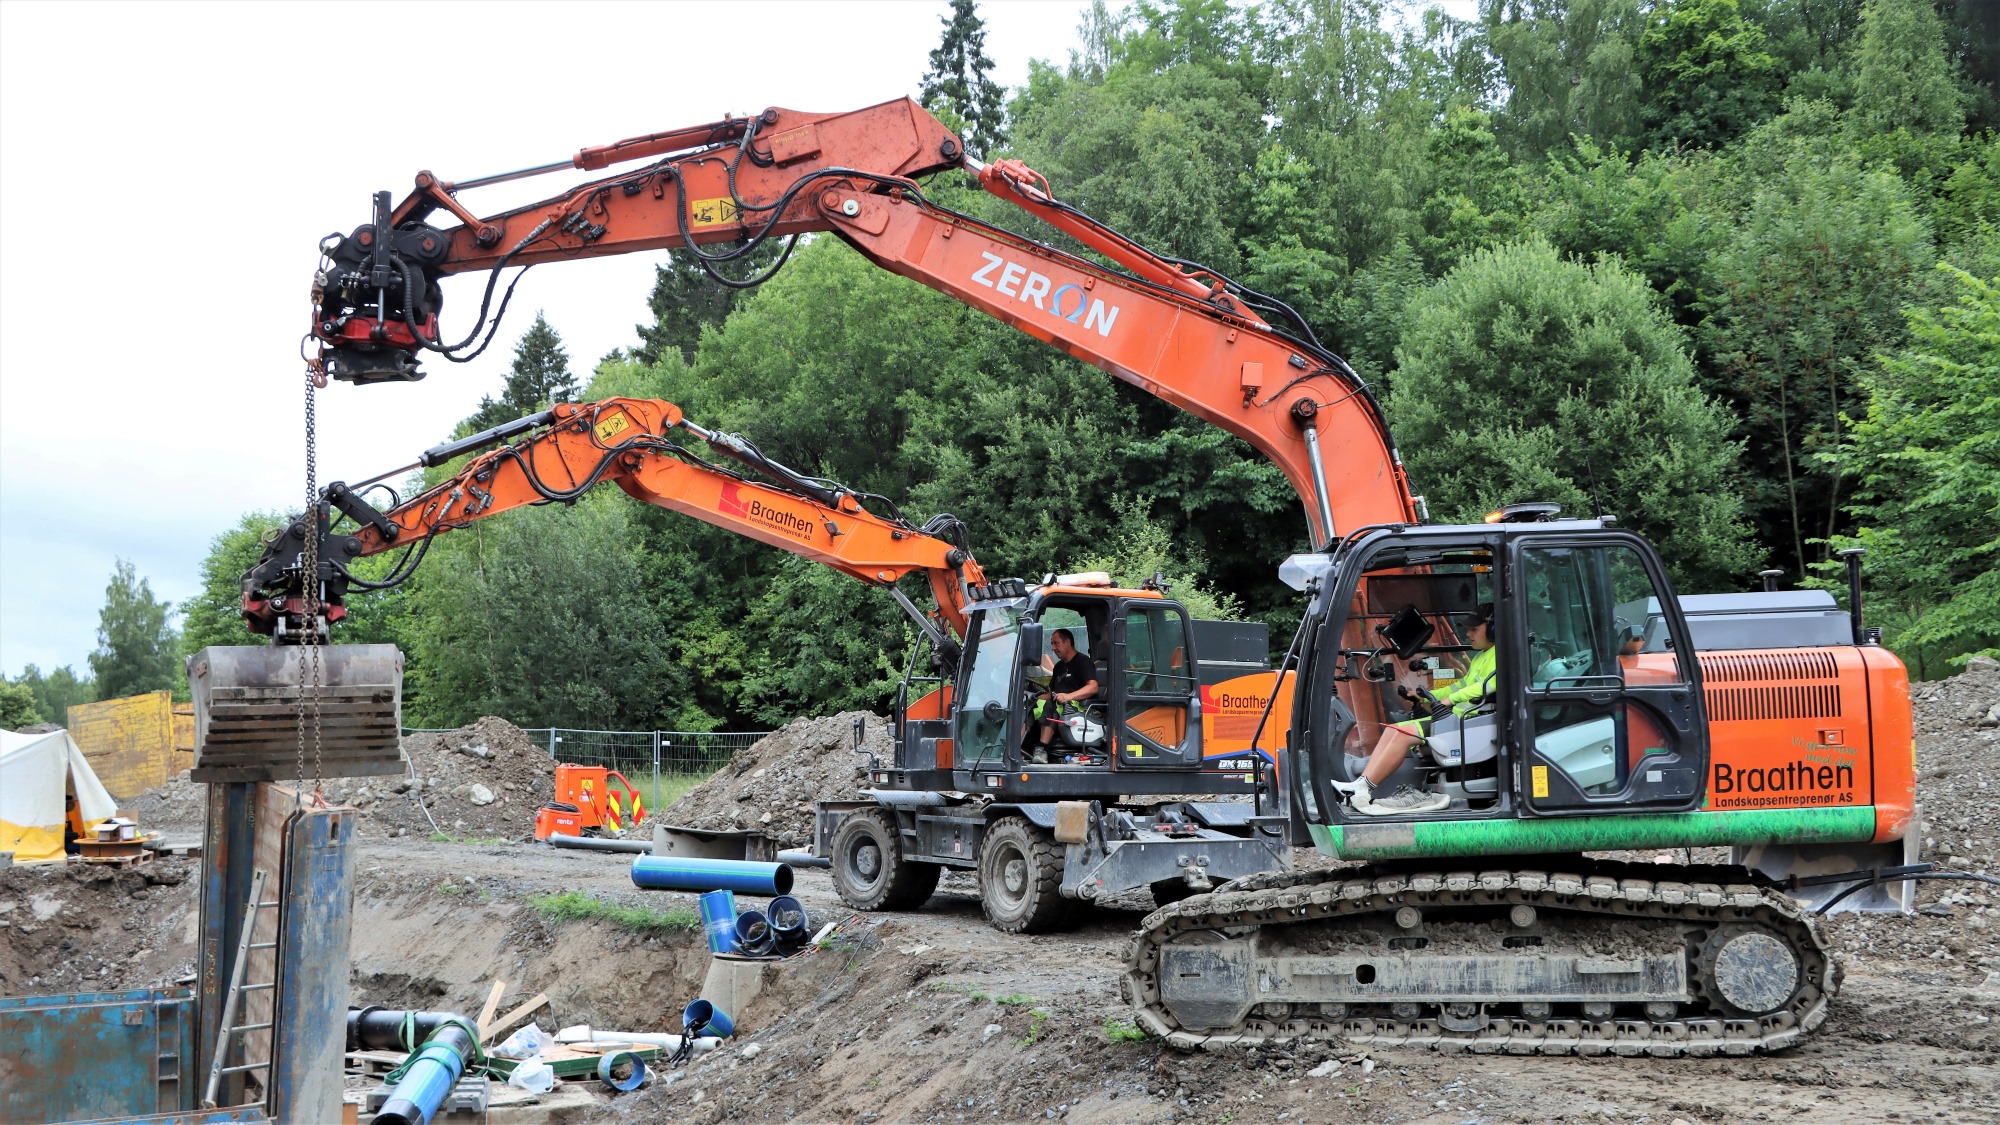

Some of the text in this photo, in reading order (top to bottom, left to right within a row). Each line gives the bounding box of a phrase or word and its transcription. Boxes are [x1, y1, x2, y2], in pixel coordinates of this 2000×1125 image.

[751, 500, 814, 534] Braathen
[1218, 759, 1236, 770] DX
[1714, 761, 1853, 793] Braathen
[1715, 792, 1853, 808] Landskapsentreprenør AS
